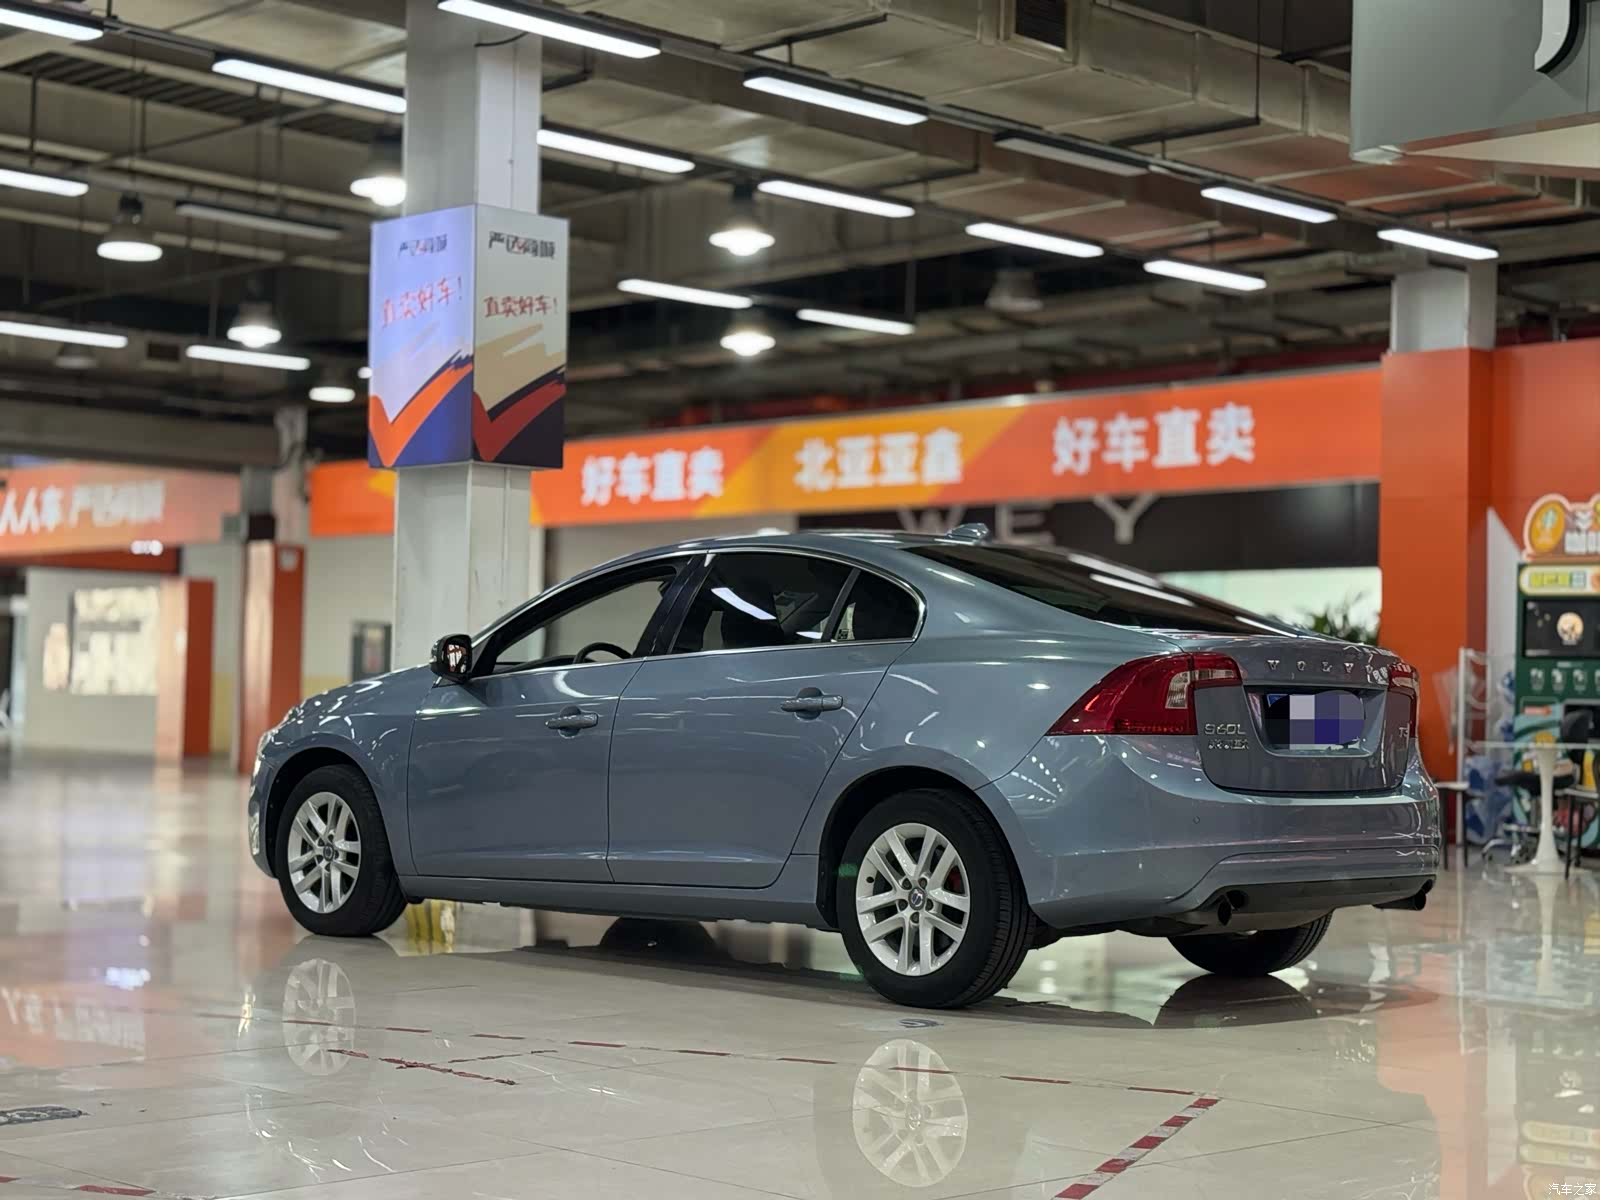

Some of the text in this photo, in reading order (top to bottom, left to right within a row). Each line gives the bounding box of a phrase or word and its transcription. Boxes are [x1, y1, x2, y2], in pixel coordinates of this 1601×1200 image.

[1052, 401, 1256, 476] 好车直卖
[580, 446, 724, 507] 好车直卖
[1204, 723, 1247, 735] S60L
